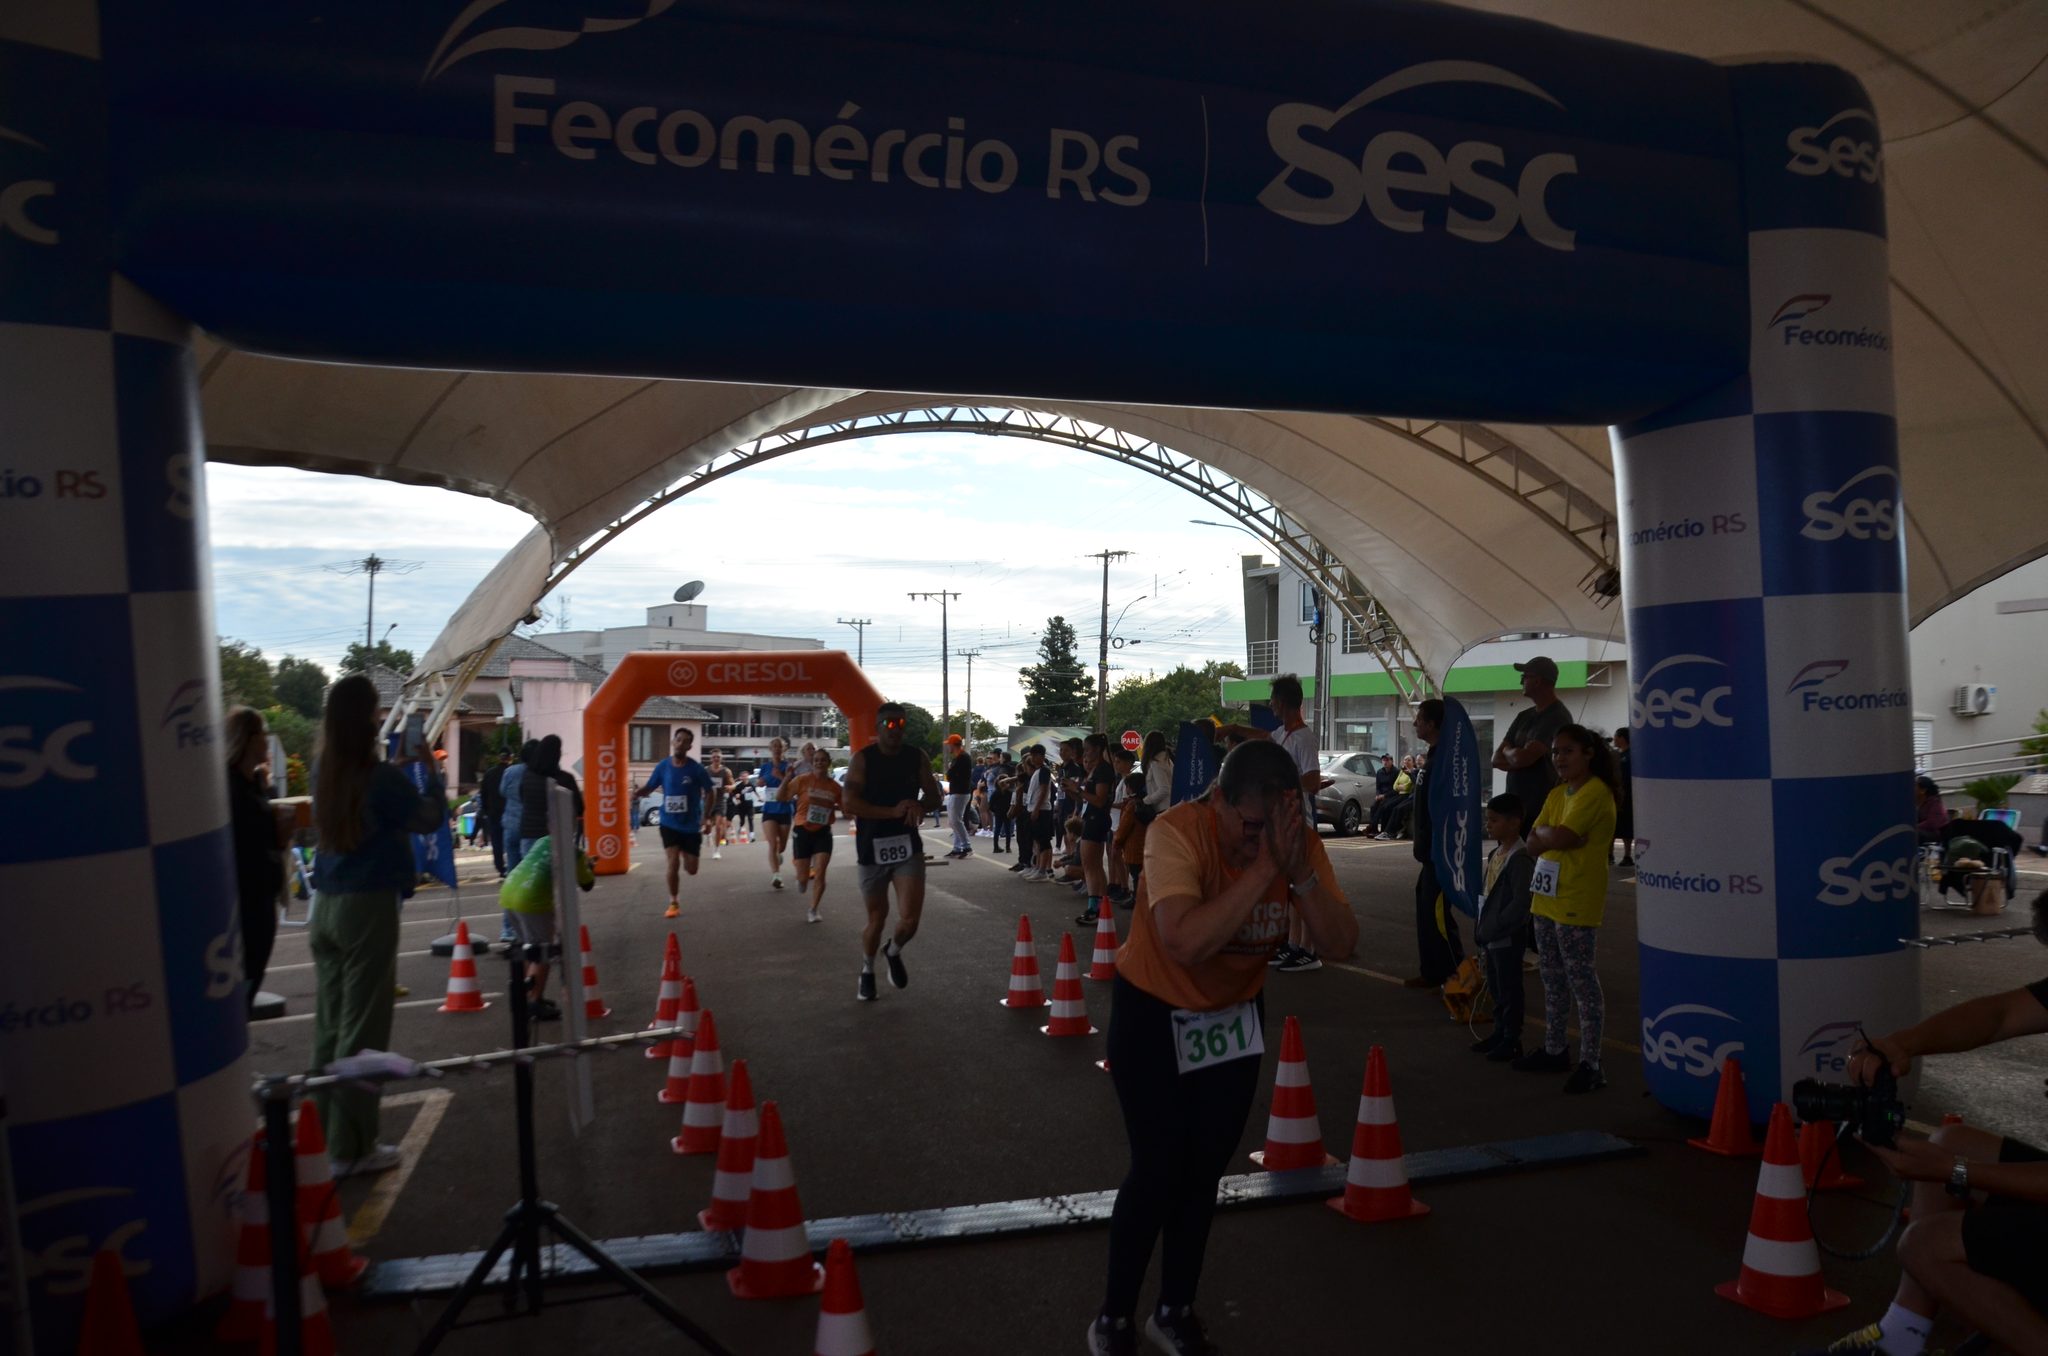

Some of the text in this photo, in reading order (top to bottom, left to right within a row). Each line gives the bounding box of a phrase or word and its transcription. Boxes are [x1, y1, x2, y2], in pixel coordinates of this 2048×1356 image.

[494, 73, 1151, 207] Fecomércio RS
[1256, 102, 1578, 251] Sesc
[55, 470, 108, 499] RS
[1712, 513, 1747, 535] RS
[706, 661, 812, 684] CRESOL
[1122, 737, 1140, 745] PARE
[598, 737, 618, 828] CRESOL
[880, 845, 907, 862] 689
[1450, 810, 1468, 892] Sesc
[1729, 874, 1763, 895] RS
[0, 982, 153, 1032] ércio RS
[1185, 1016, 1246, 1063] 361
